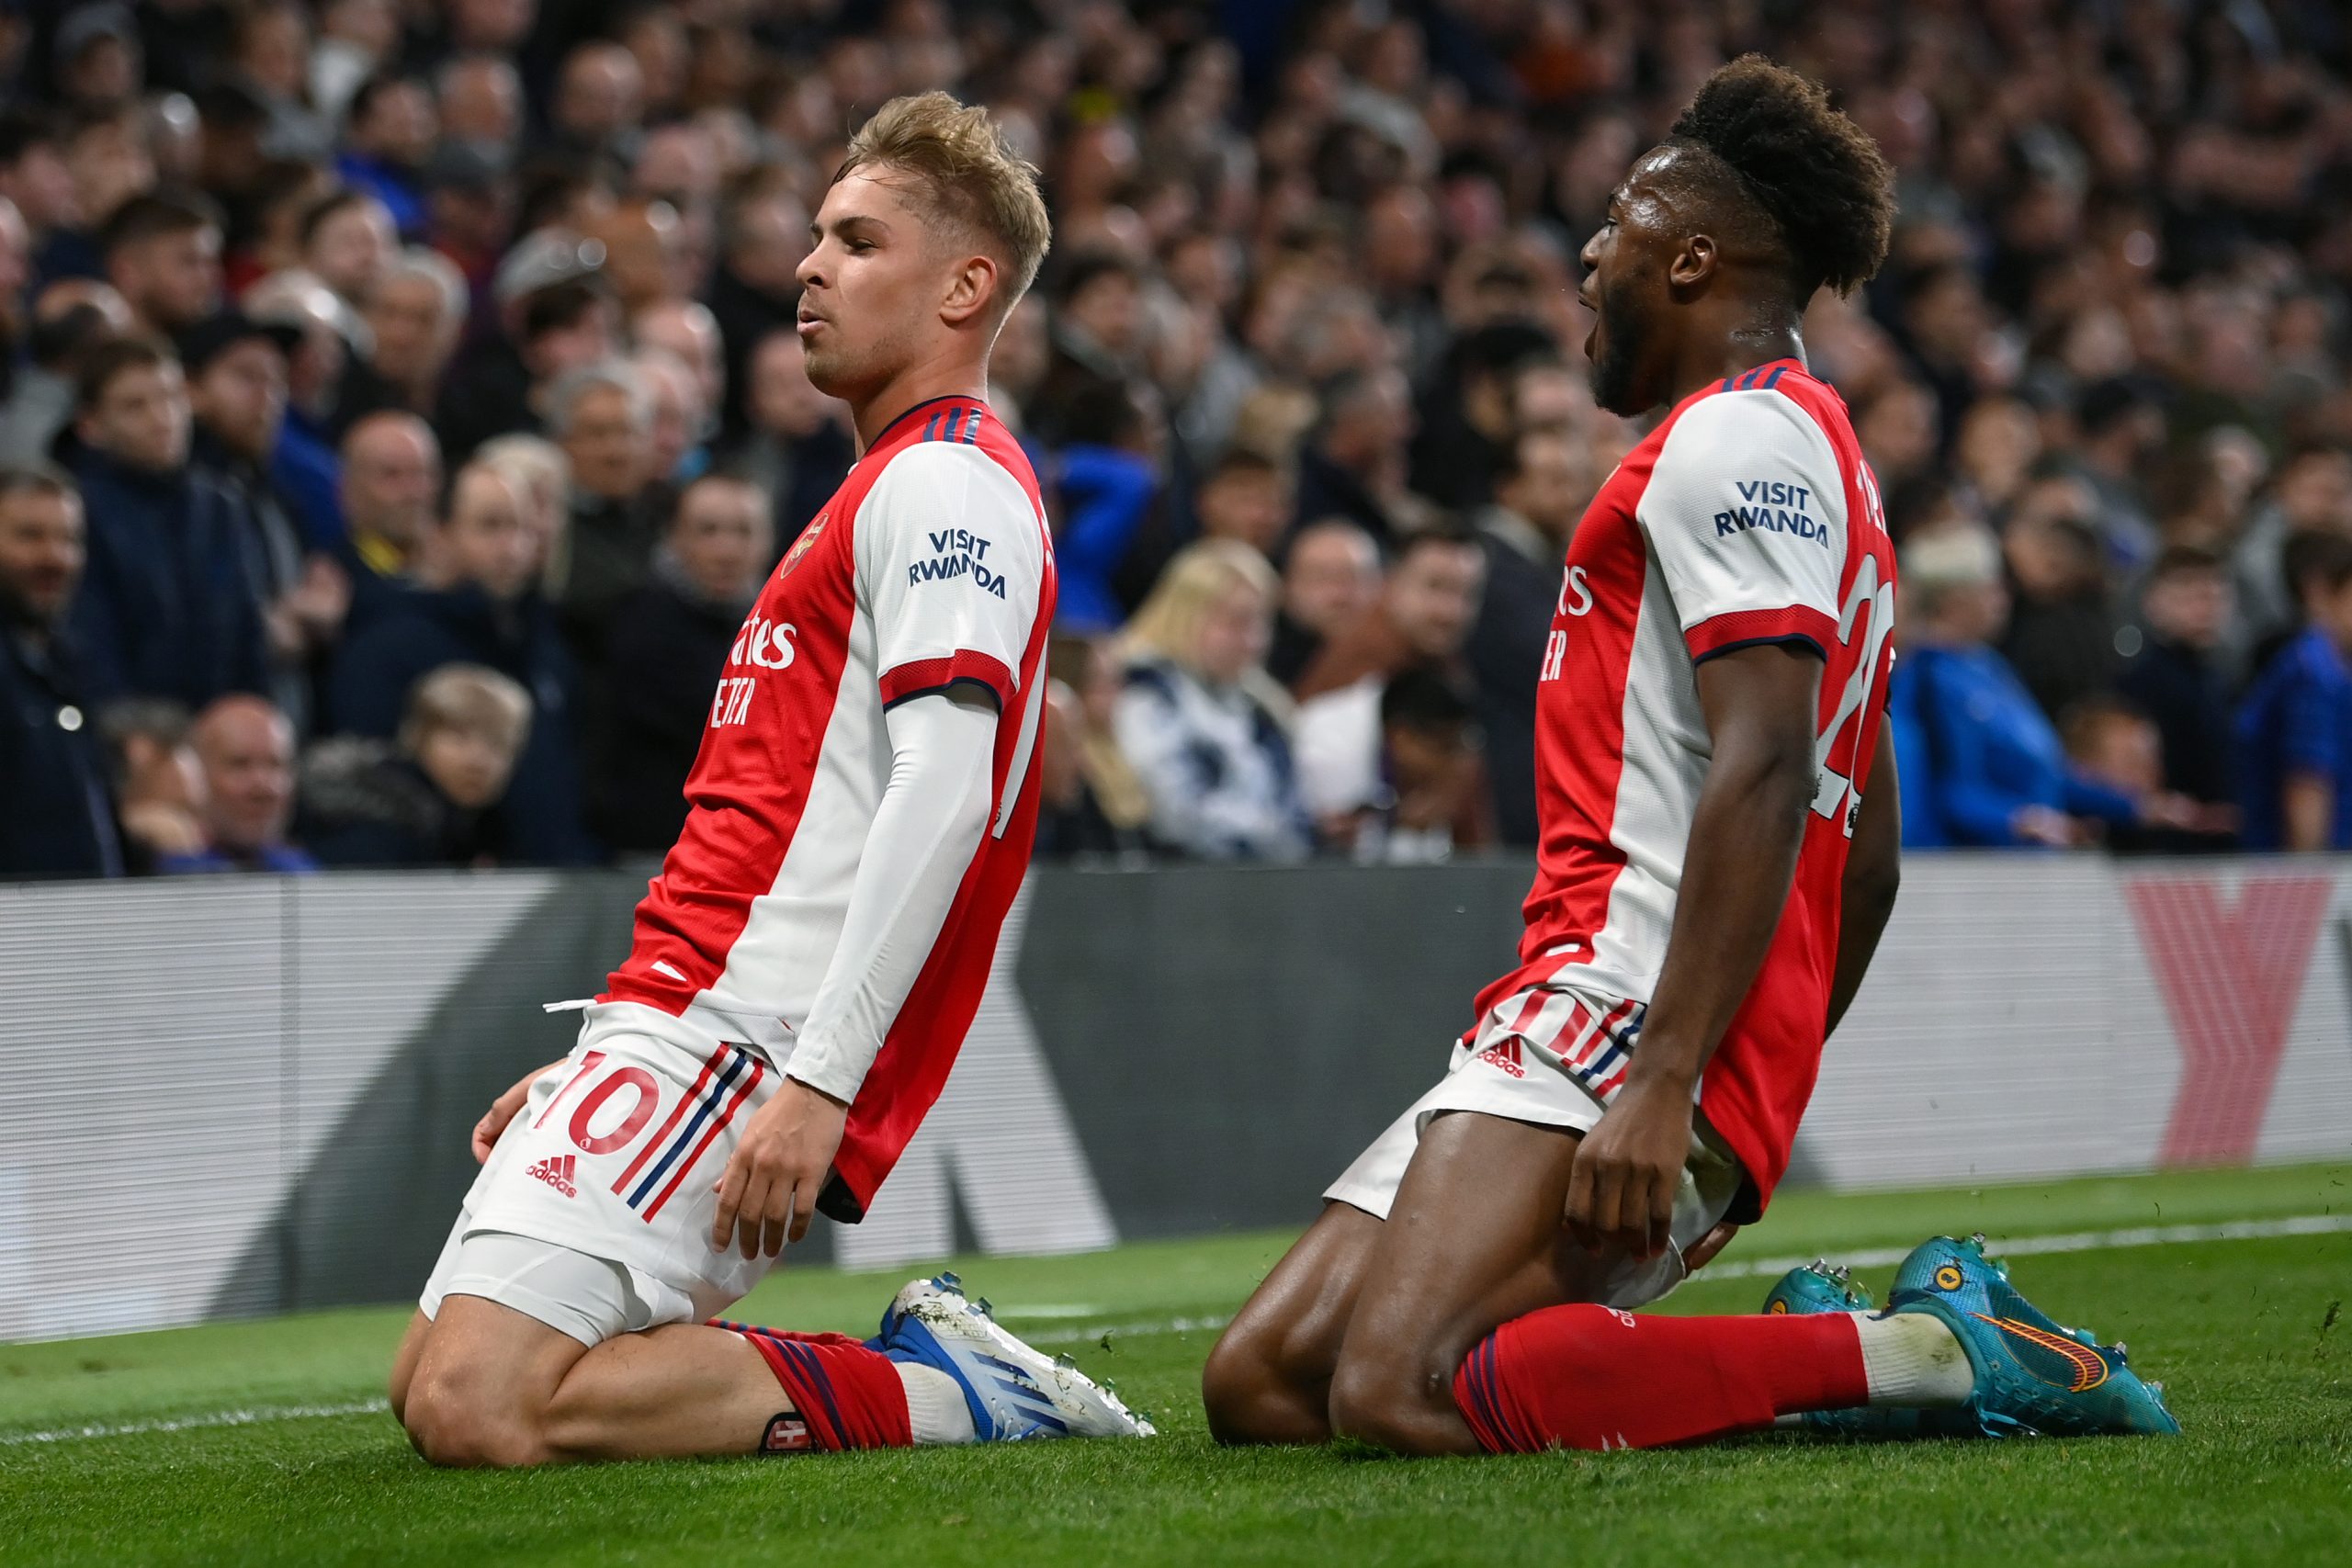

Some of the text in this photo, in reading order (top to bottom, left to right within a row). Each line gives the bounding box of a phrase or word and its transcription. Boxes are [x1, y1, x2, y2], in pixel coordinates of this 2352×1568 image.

[1736, 480, 1810, 511] VISIT
[928, 528, 991, 560] VISIT
[1713, 506, 1829, 549] RWANDA
[908, 552, 1006, 600] RWANDA
[1477, 1050, 1525, 1078] adidas
[533, 1050, 660, 1156] 10
[525, 1163, 578, 1199] adidas
